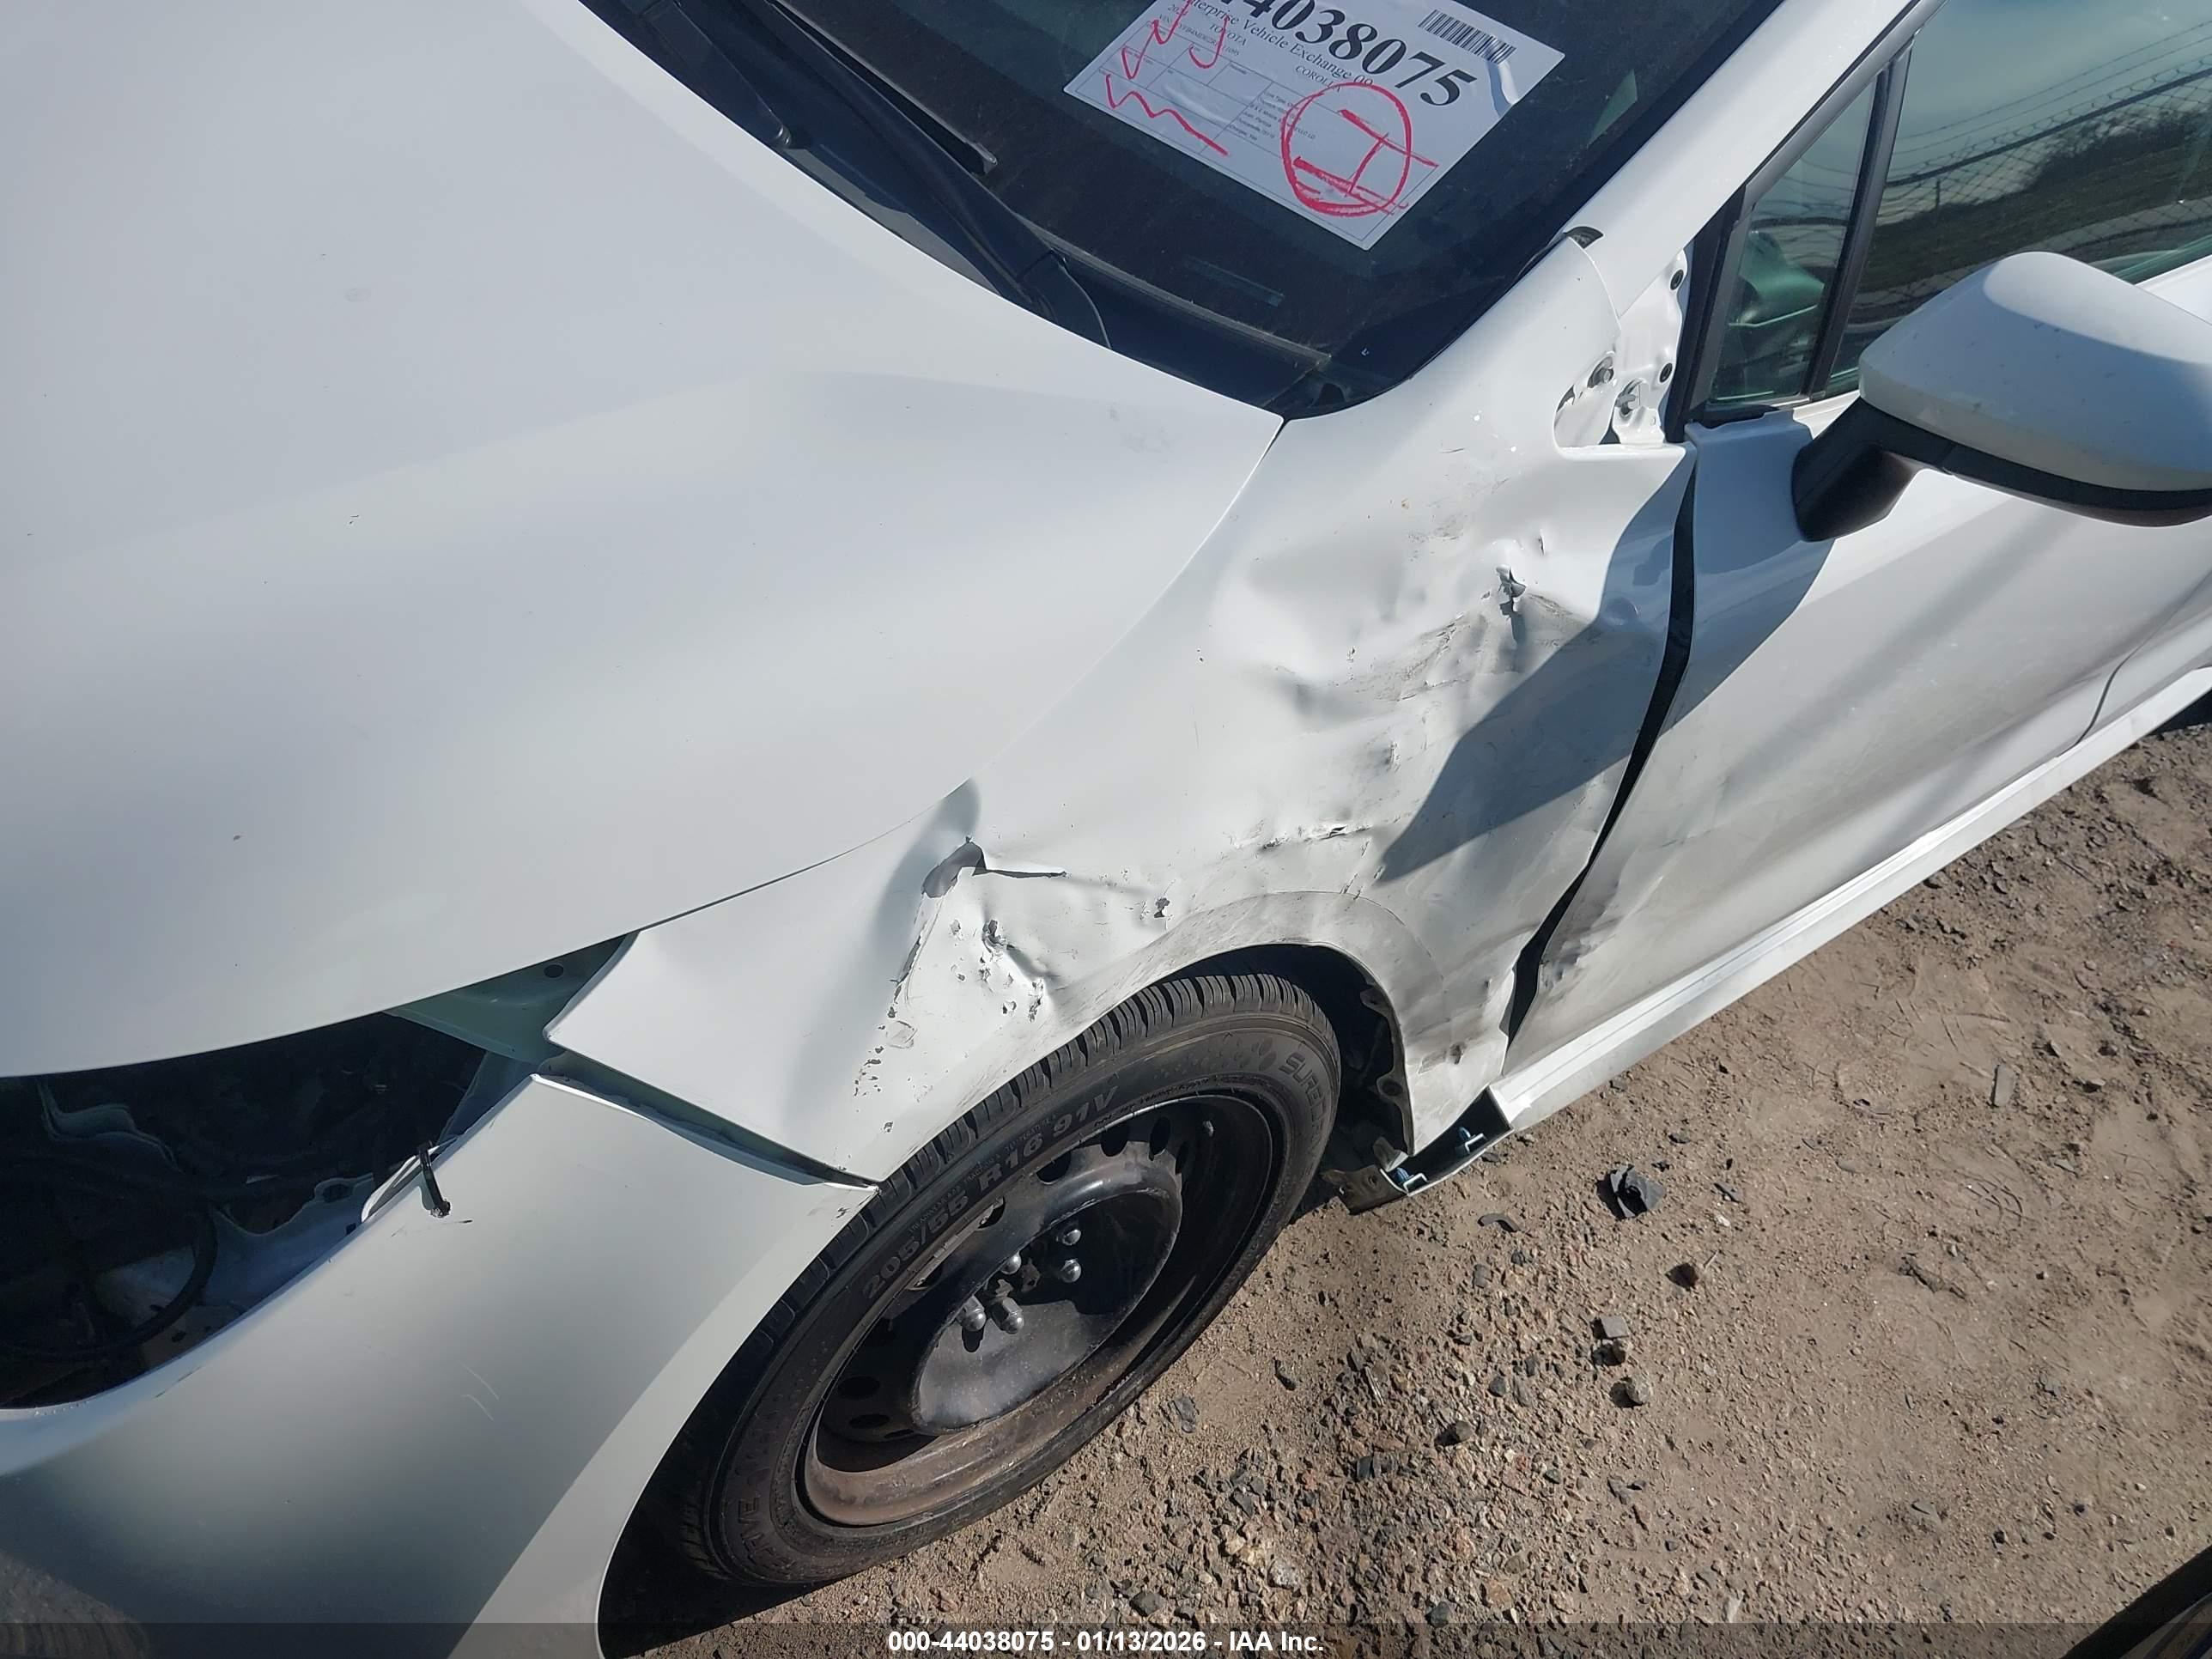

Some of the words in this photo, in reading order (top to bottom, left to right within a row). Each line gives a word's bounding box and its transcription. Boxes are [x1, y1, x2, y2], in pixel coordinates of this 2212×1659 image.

[1219, 0, 1478, 106] 4038075
[1243, 18, 1289, 49] Vehicle
[1289, 43, 1352, 80] Exchange
[862, 1190, 969, 1299] 205/55
[978, 1133, 1044, 1193] R16
[1053, 1086, 1119, 1138] 91V
